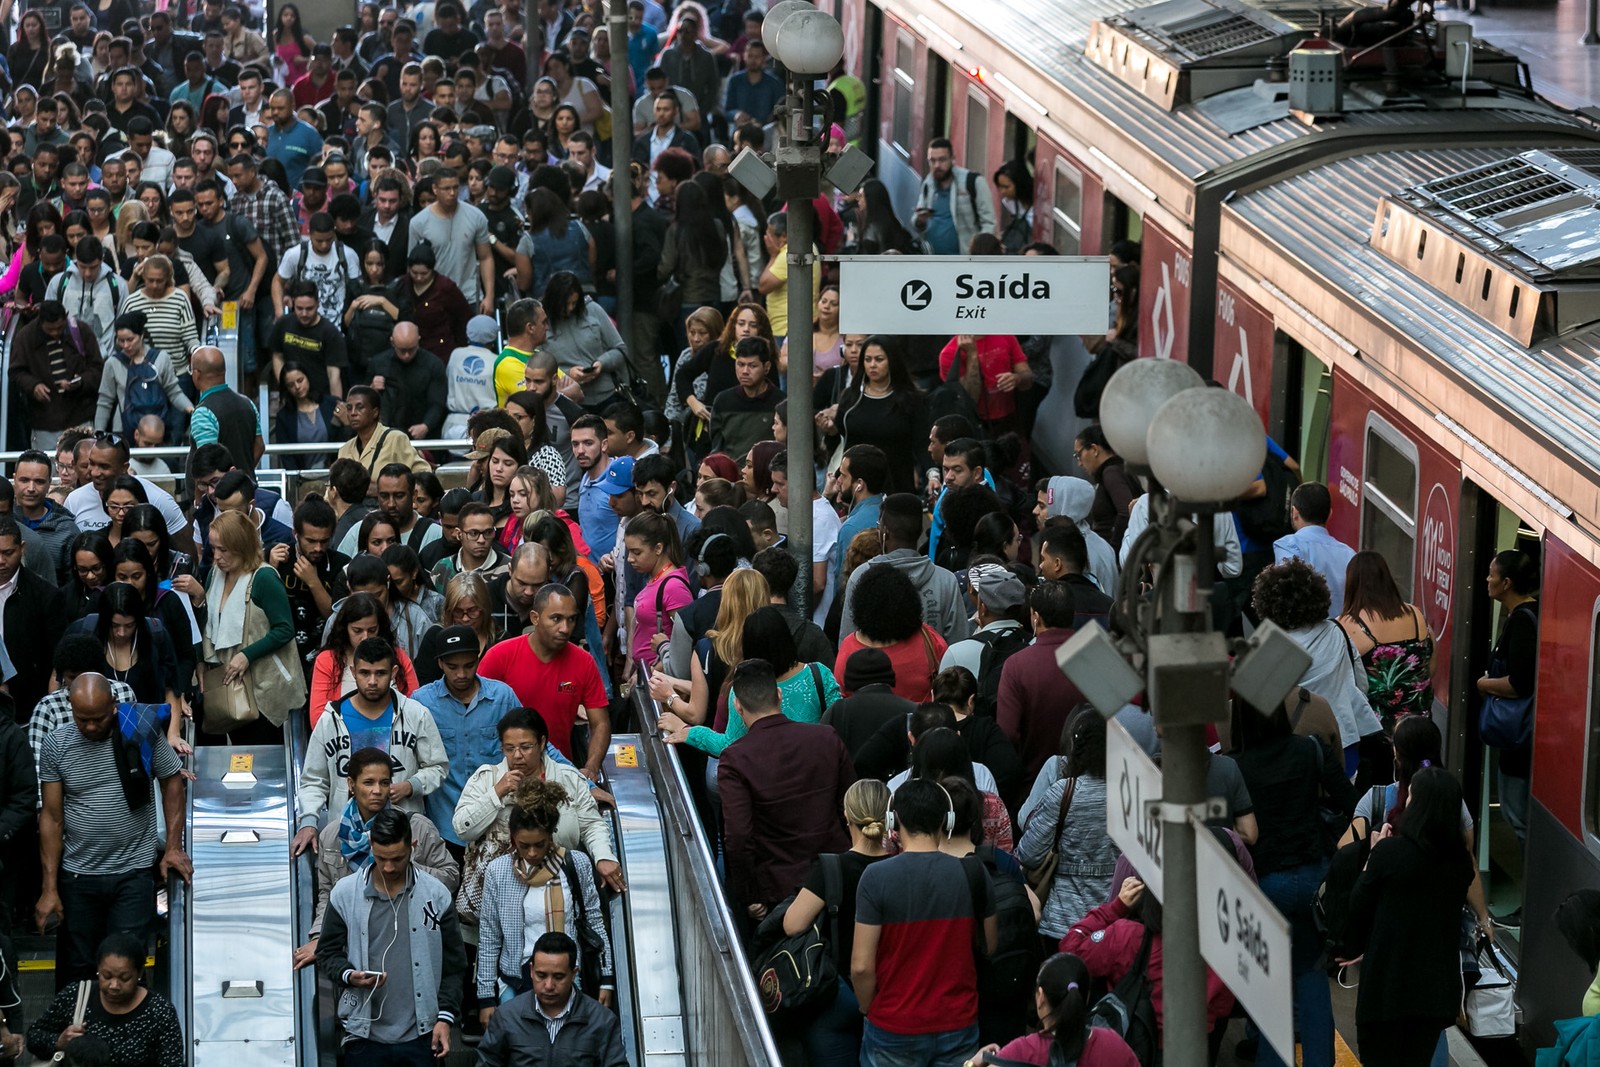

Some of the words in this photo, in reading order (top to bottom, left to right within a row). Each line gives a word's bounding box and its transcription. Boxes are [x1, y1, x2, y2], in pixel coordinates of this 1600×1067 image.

[955, 272, 1050, 300] Saída
[955, 304, 987, 320] Exit
[1218, 289, 1235, 327] F006
[1437, 547, 1450, 569] NOVO
[1437, 568, 1449, 591] TREM
[1136, 775, 1161, 868] Luz
[1235, 897, 1270, 977] Saída
[342, 991, 358, 1008] 45
